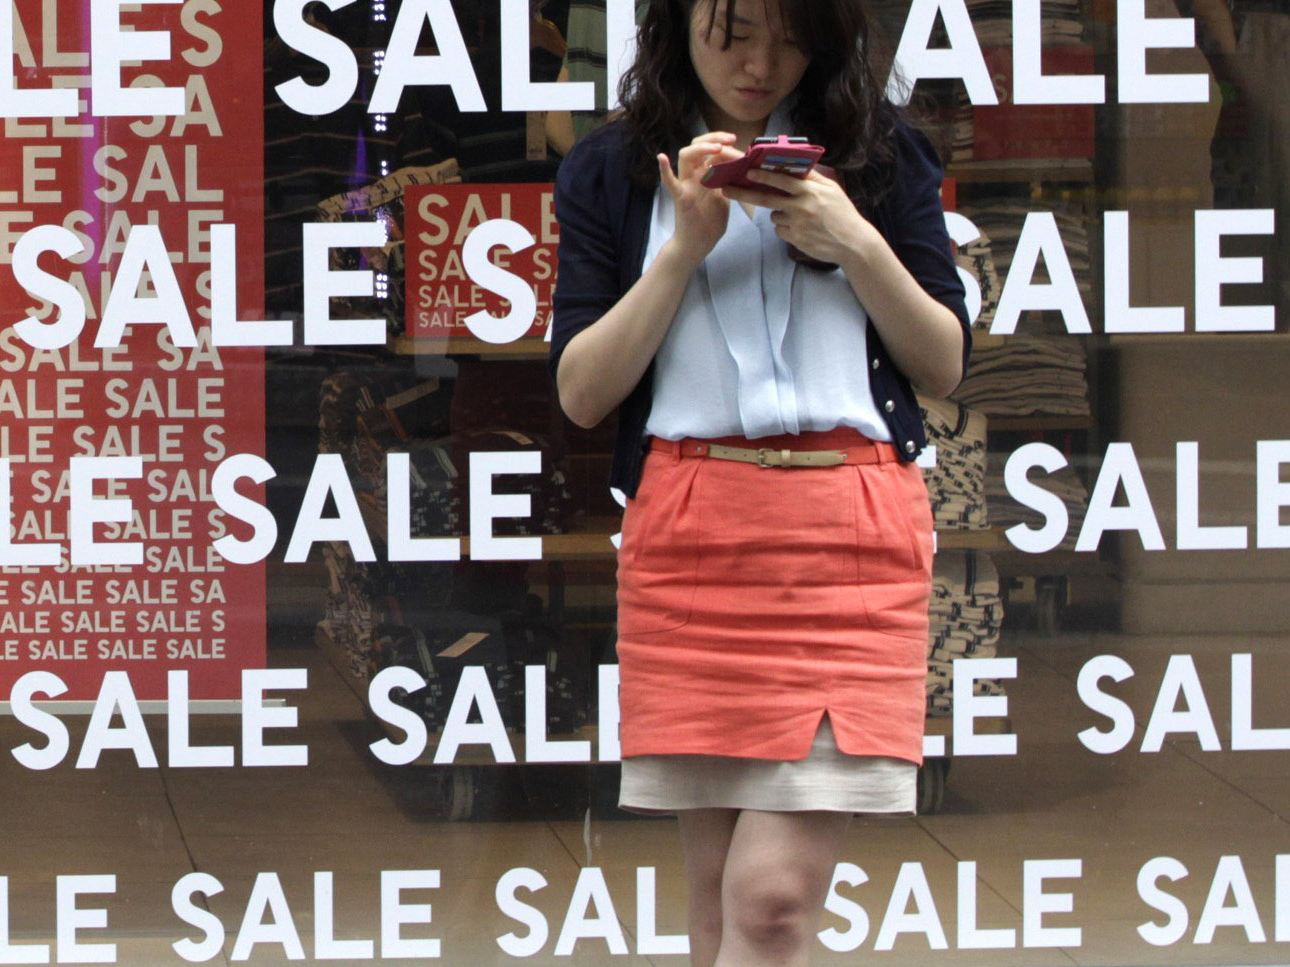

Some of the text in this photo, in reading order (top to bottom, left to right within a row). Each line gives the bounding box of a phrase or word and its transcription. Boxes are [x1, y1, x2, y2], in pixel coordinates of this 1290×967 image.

[93, 144, 224, 203] SAL
[12, 220, 387, 350] SALE
[419, 285, 486, 307] SALE
[420, 312, 467, 327] SALE
[157, 325, 224, 371] SA
[105, 377, 226, 418] SALE
[73, 424, 184, 462] SALE
[203, 424, 226, 461] S
[207, 508, 227, 538] S
[212, 452, 542, 564] SALE
[146, 545, 226, 573] SALE
[20, 579, 94, 605] SALE
[104, 579, 178, 605] SALE
[189, 578, 226, 604] SA
[60, 611, 126, 634] SALE
[135, 610, 201, 633] SALE
[210, 610, 225, 633] S
[28, 639, 88, 661] SALE
[97, 639, 158, 660] SALE
[165, 638, 226, 660] SALE
[10, 669, 307, 769] SALE
[1077, 654, 1290, 753] SAL
[172, 870, 441, 962] SALE
[496, 868, 692, 957] SAL
[818, 860, 1082, 952] SALE
